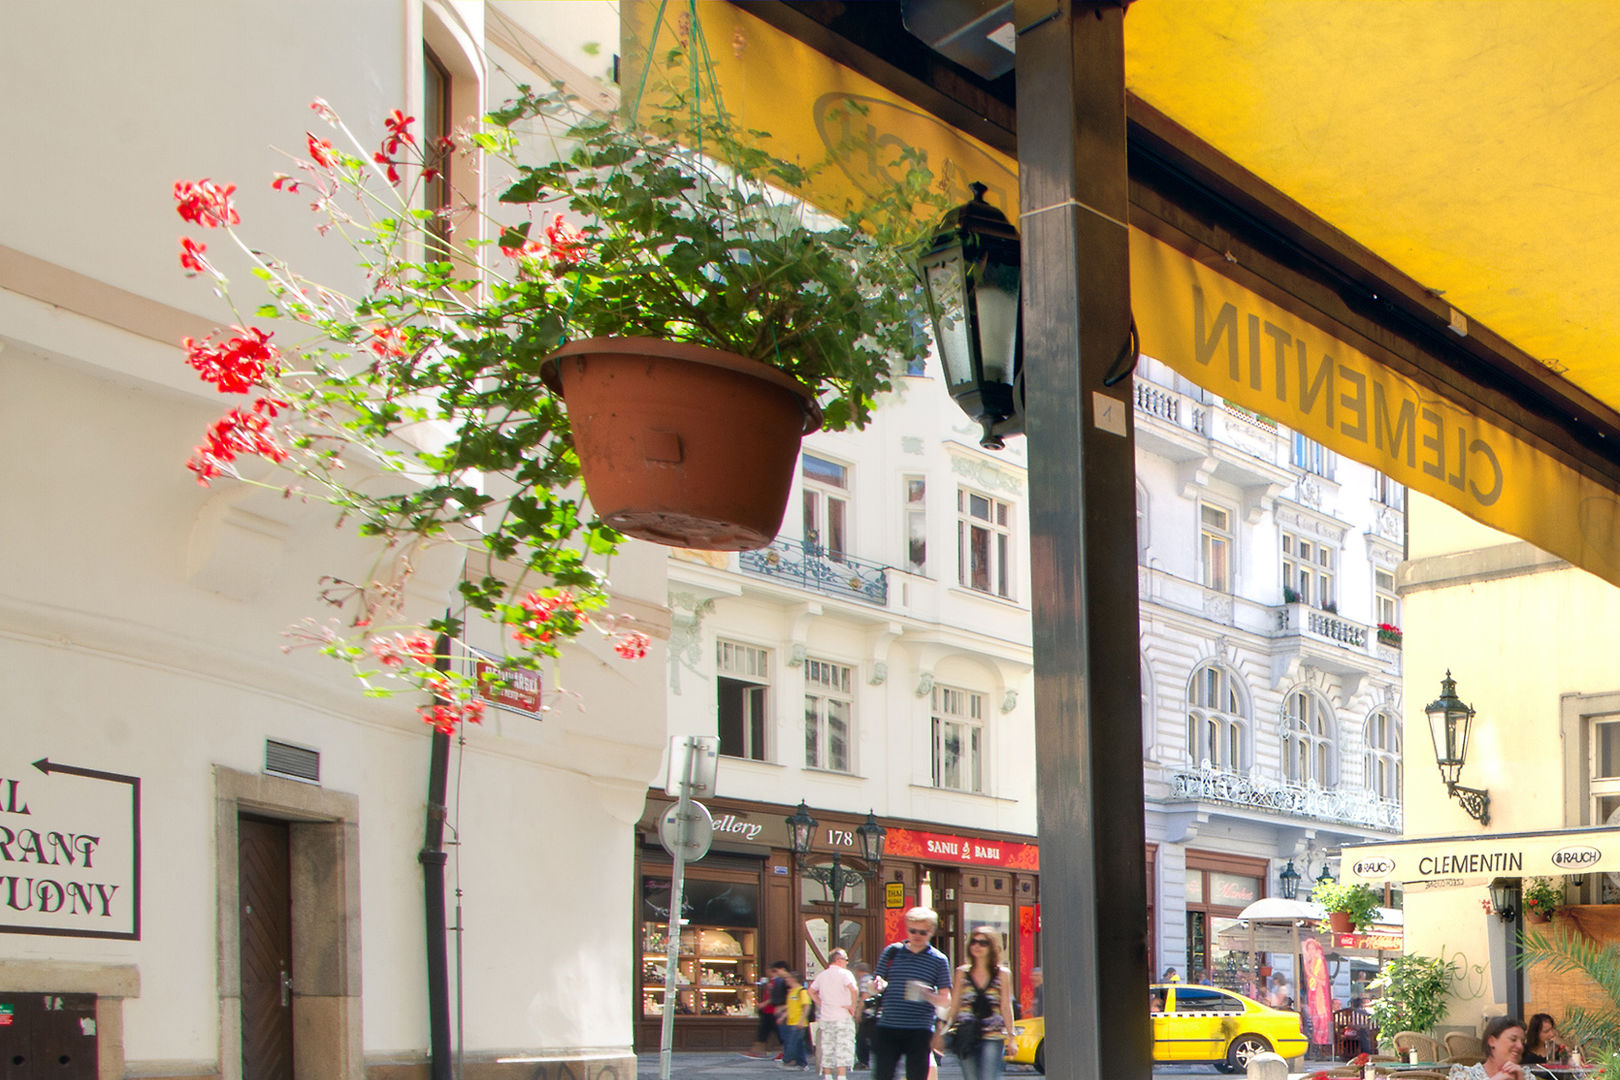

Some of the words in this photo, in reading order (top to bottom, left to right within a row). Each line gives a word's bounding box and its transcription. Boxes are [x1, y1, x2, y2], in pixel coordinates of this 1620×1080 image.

[711, 815, 762, 840] ellery
[828, 829, 854, 847] 178
[927, 840, 958, 855] SANU
[974, 846, 1000, 860] BABU
[1362, 862, 1393, 874] RAUCH
[1419, 852, 1523, 876] CLEMENTIN
[1563, 851, 1598, 864] RAUCH
[0, 876, 120, 917] UDNY
